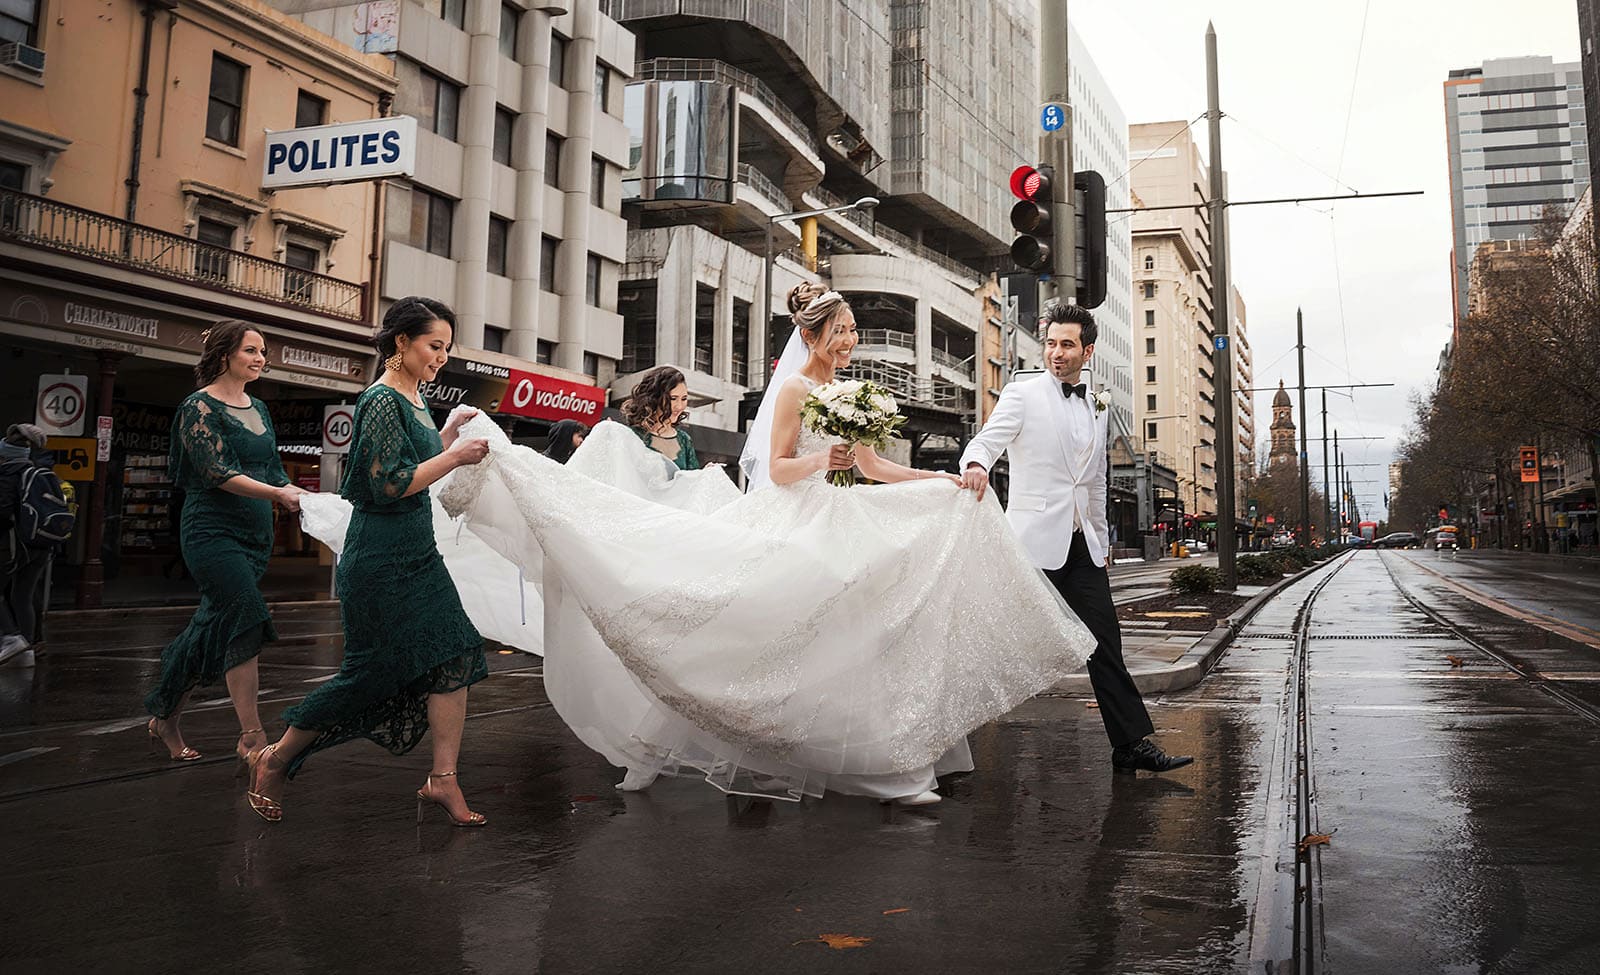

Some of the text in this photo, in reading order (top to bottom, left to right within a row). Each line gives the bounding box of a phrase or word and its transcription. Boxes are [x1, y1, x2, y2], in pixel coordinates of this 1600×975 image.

[1045, 116, 1058, 126] 14
[1046, 106, 1056, 116] G
[267, 130, 401, 175] POLITES
[63, 302, 160, 339] CHARLESWORTH
[281, 345, 350, 375] CHARLESWORTH
[418, 382, 468, 403] BEAUTY
[535, 389, 597, 415] vodafone
[45, 395, 77, 415] 40
[329, 421, 350, 437] 40
[112, 431, 140, 449] AIR
